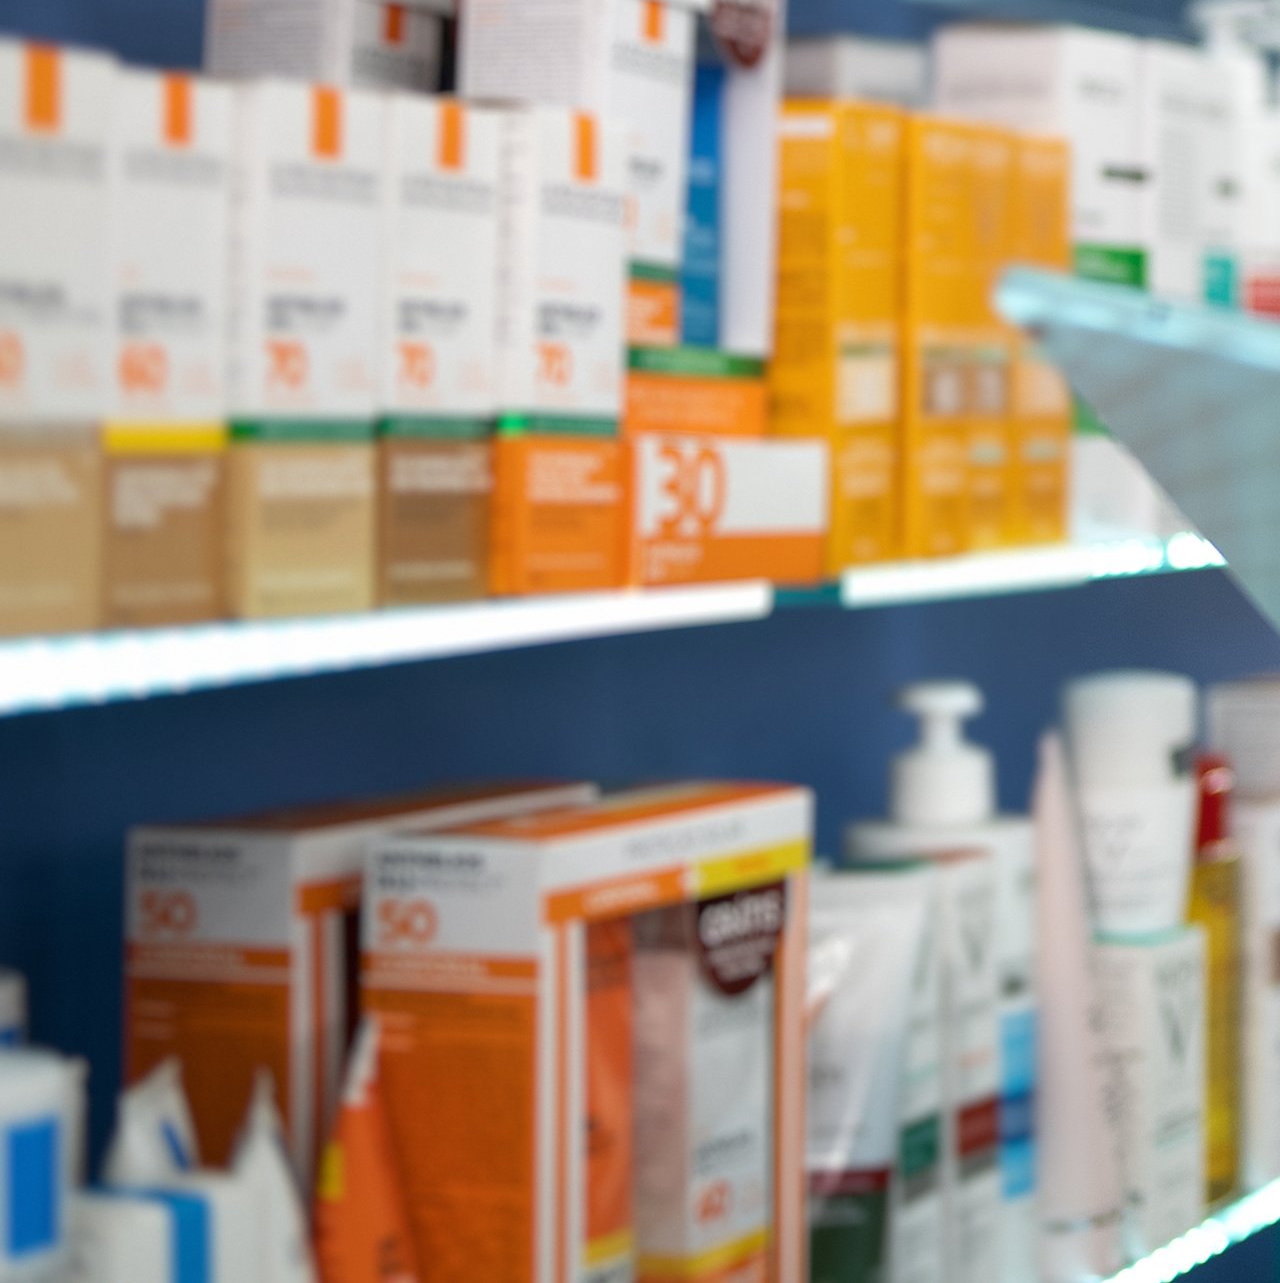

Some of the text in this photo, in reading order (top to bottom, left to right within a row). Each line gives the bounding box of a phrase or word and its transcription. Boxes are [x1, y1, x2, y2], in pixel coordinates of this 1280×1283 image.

[264, 340, 307, 389] 70
[396, 341, 436, 388] 70
[535, 342, 573, 386] 70
[656, 440, 727, 536] 30
[140, 890, 197, 934] 50
[376, 898, 439, 944] 50
